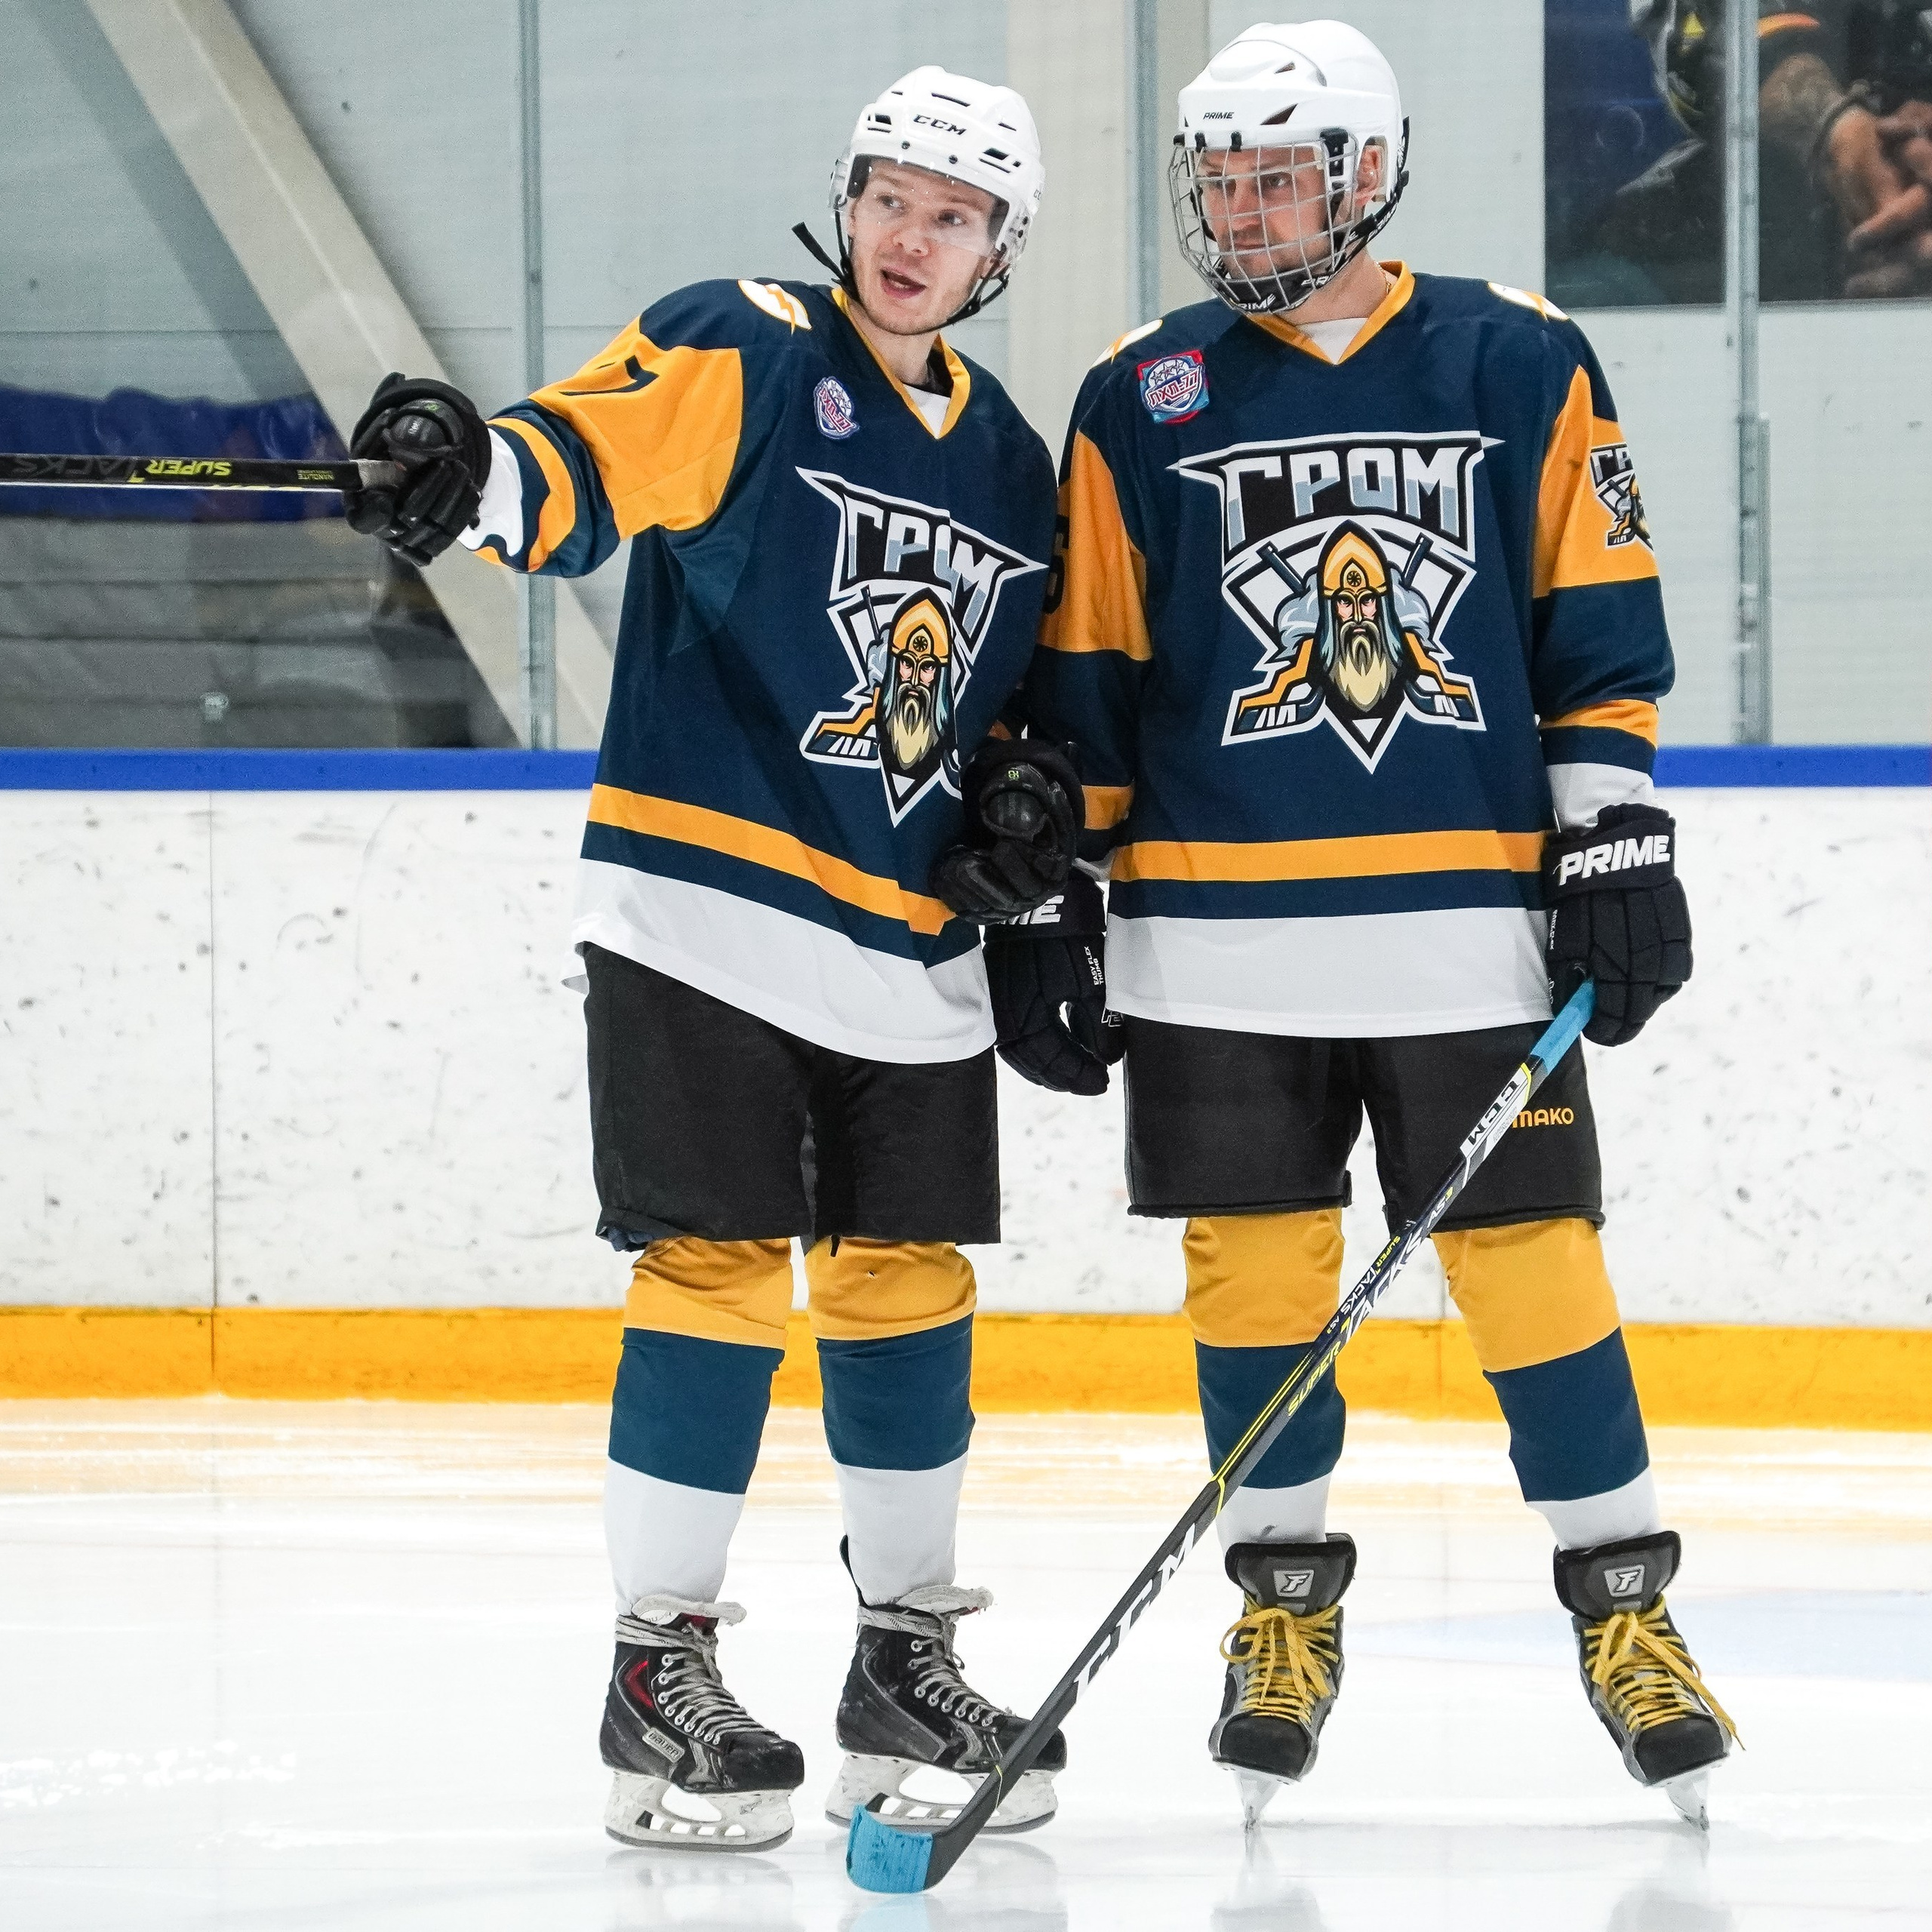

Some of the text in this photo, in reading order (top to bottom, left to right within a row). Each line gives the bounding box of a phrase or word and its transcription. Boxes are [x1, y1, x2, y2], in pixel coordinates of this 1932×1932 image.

[913, 114, 968, 136] CCM
[1203, 112, 1235, 120] PRIME
[1238, 294, 1276, 310] RIME
[145, 459, 232, 476] SUPER
[1590, 448, 1632, 484] ГР
[1219, 446, 1472, 552] ГРОМ
[1559, 835, 1671, 886] PRIME
[1468, 1080, 1520, 1146] CCM
[1376, 1235, 1401, 1268] SUPER
[1340, 1267, 1381, 1315] TACKS
[1287, 1340, 1341, 1417] SUPER
[1074, 1523, 1196, 1703] CCM
